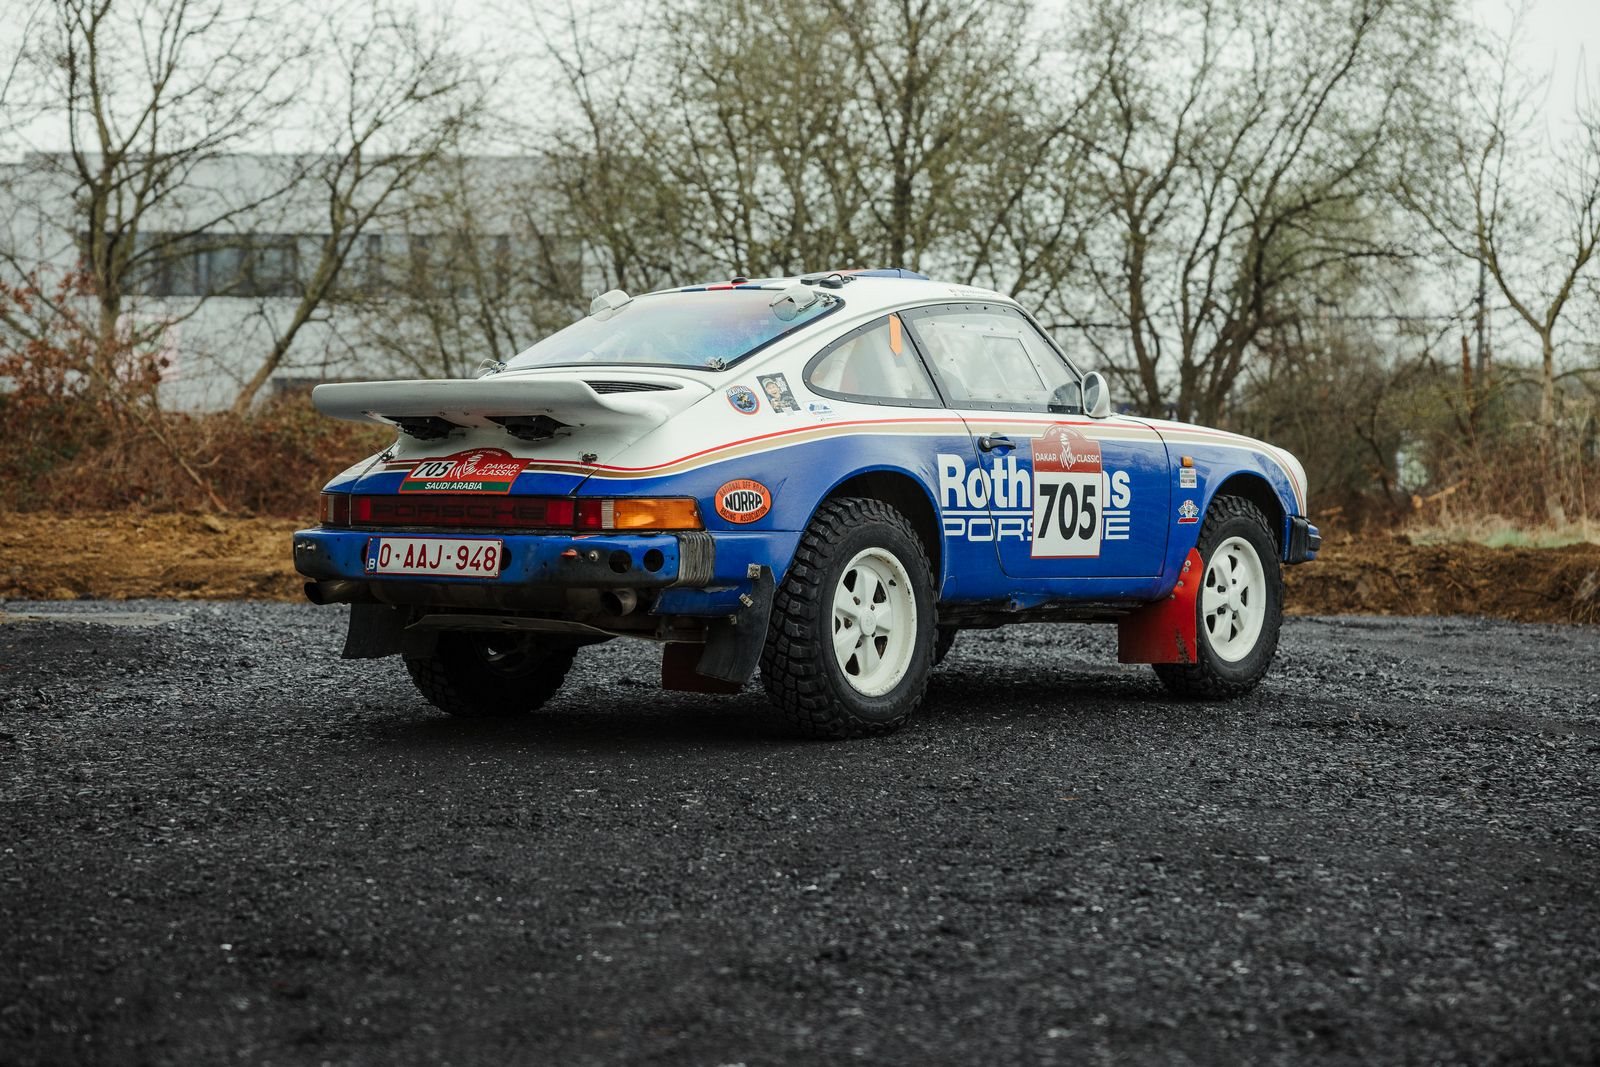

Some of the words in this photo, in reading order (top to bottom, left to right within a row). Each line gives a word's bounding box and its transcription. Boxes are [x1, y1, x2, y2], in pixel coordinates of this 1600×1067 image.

[1035, 453, 1057, 462] DAKAR
[1077, 454, 1100, 464] CLASSIC
[414, 462, 455, 477] 705
[425, 482, 450, 490] SAUDI
[450, 482, 482, 490] ARABIA
[724, 491, 763, 512] NORRA
[372, 504, 545, 519] PORSCHE
[1037, 482, 1097, 541] 705
[368, 558, 376, 569] B
